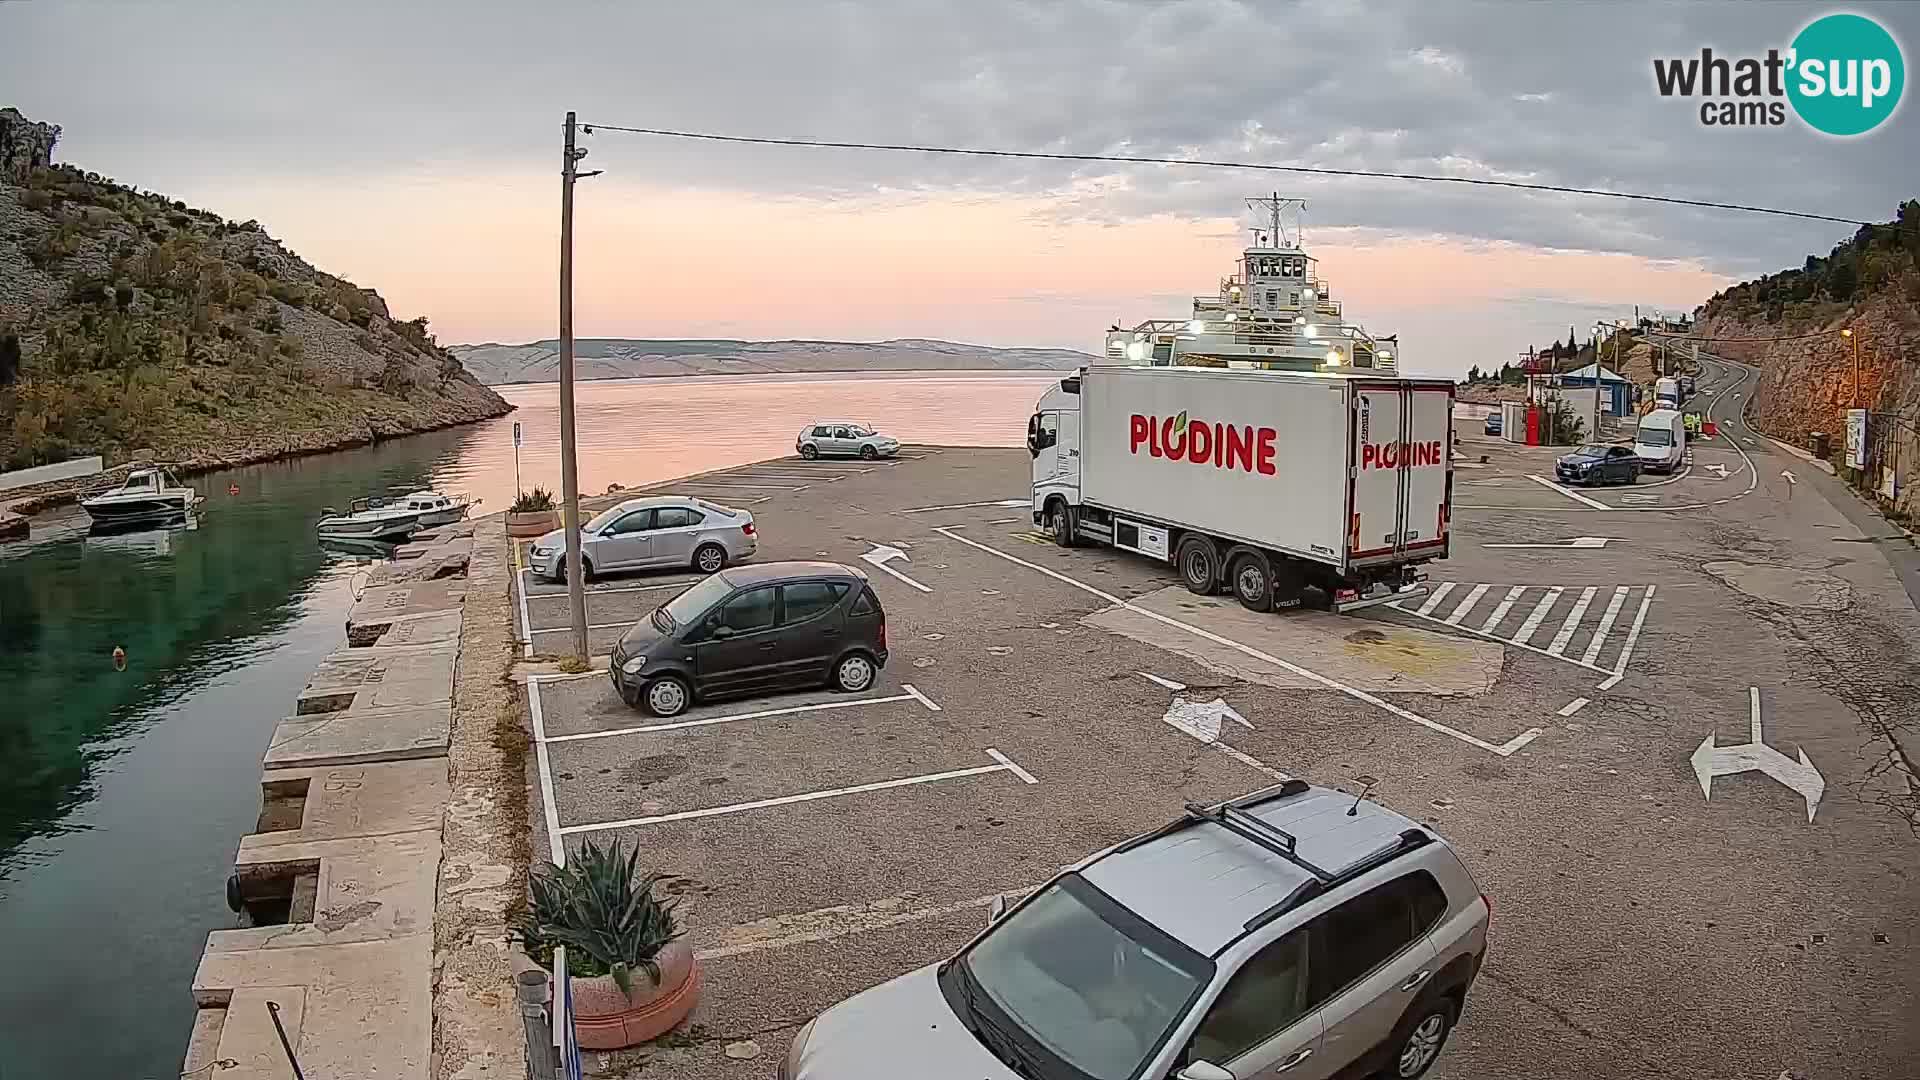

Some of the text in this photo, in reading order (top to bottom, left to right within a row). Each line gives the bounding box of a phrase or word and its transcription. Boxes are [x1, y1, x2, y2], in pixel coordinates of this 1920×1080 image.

[1131, 412, 1276, 475] PLODINE
[1362, 441, 1441, 470] PLODINE
[1275, 598, 1300, 608] VOLVO
